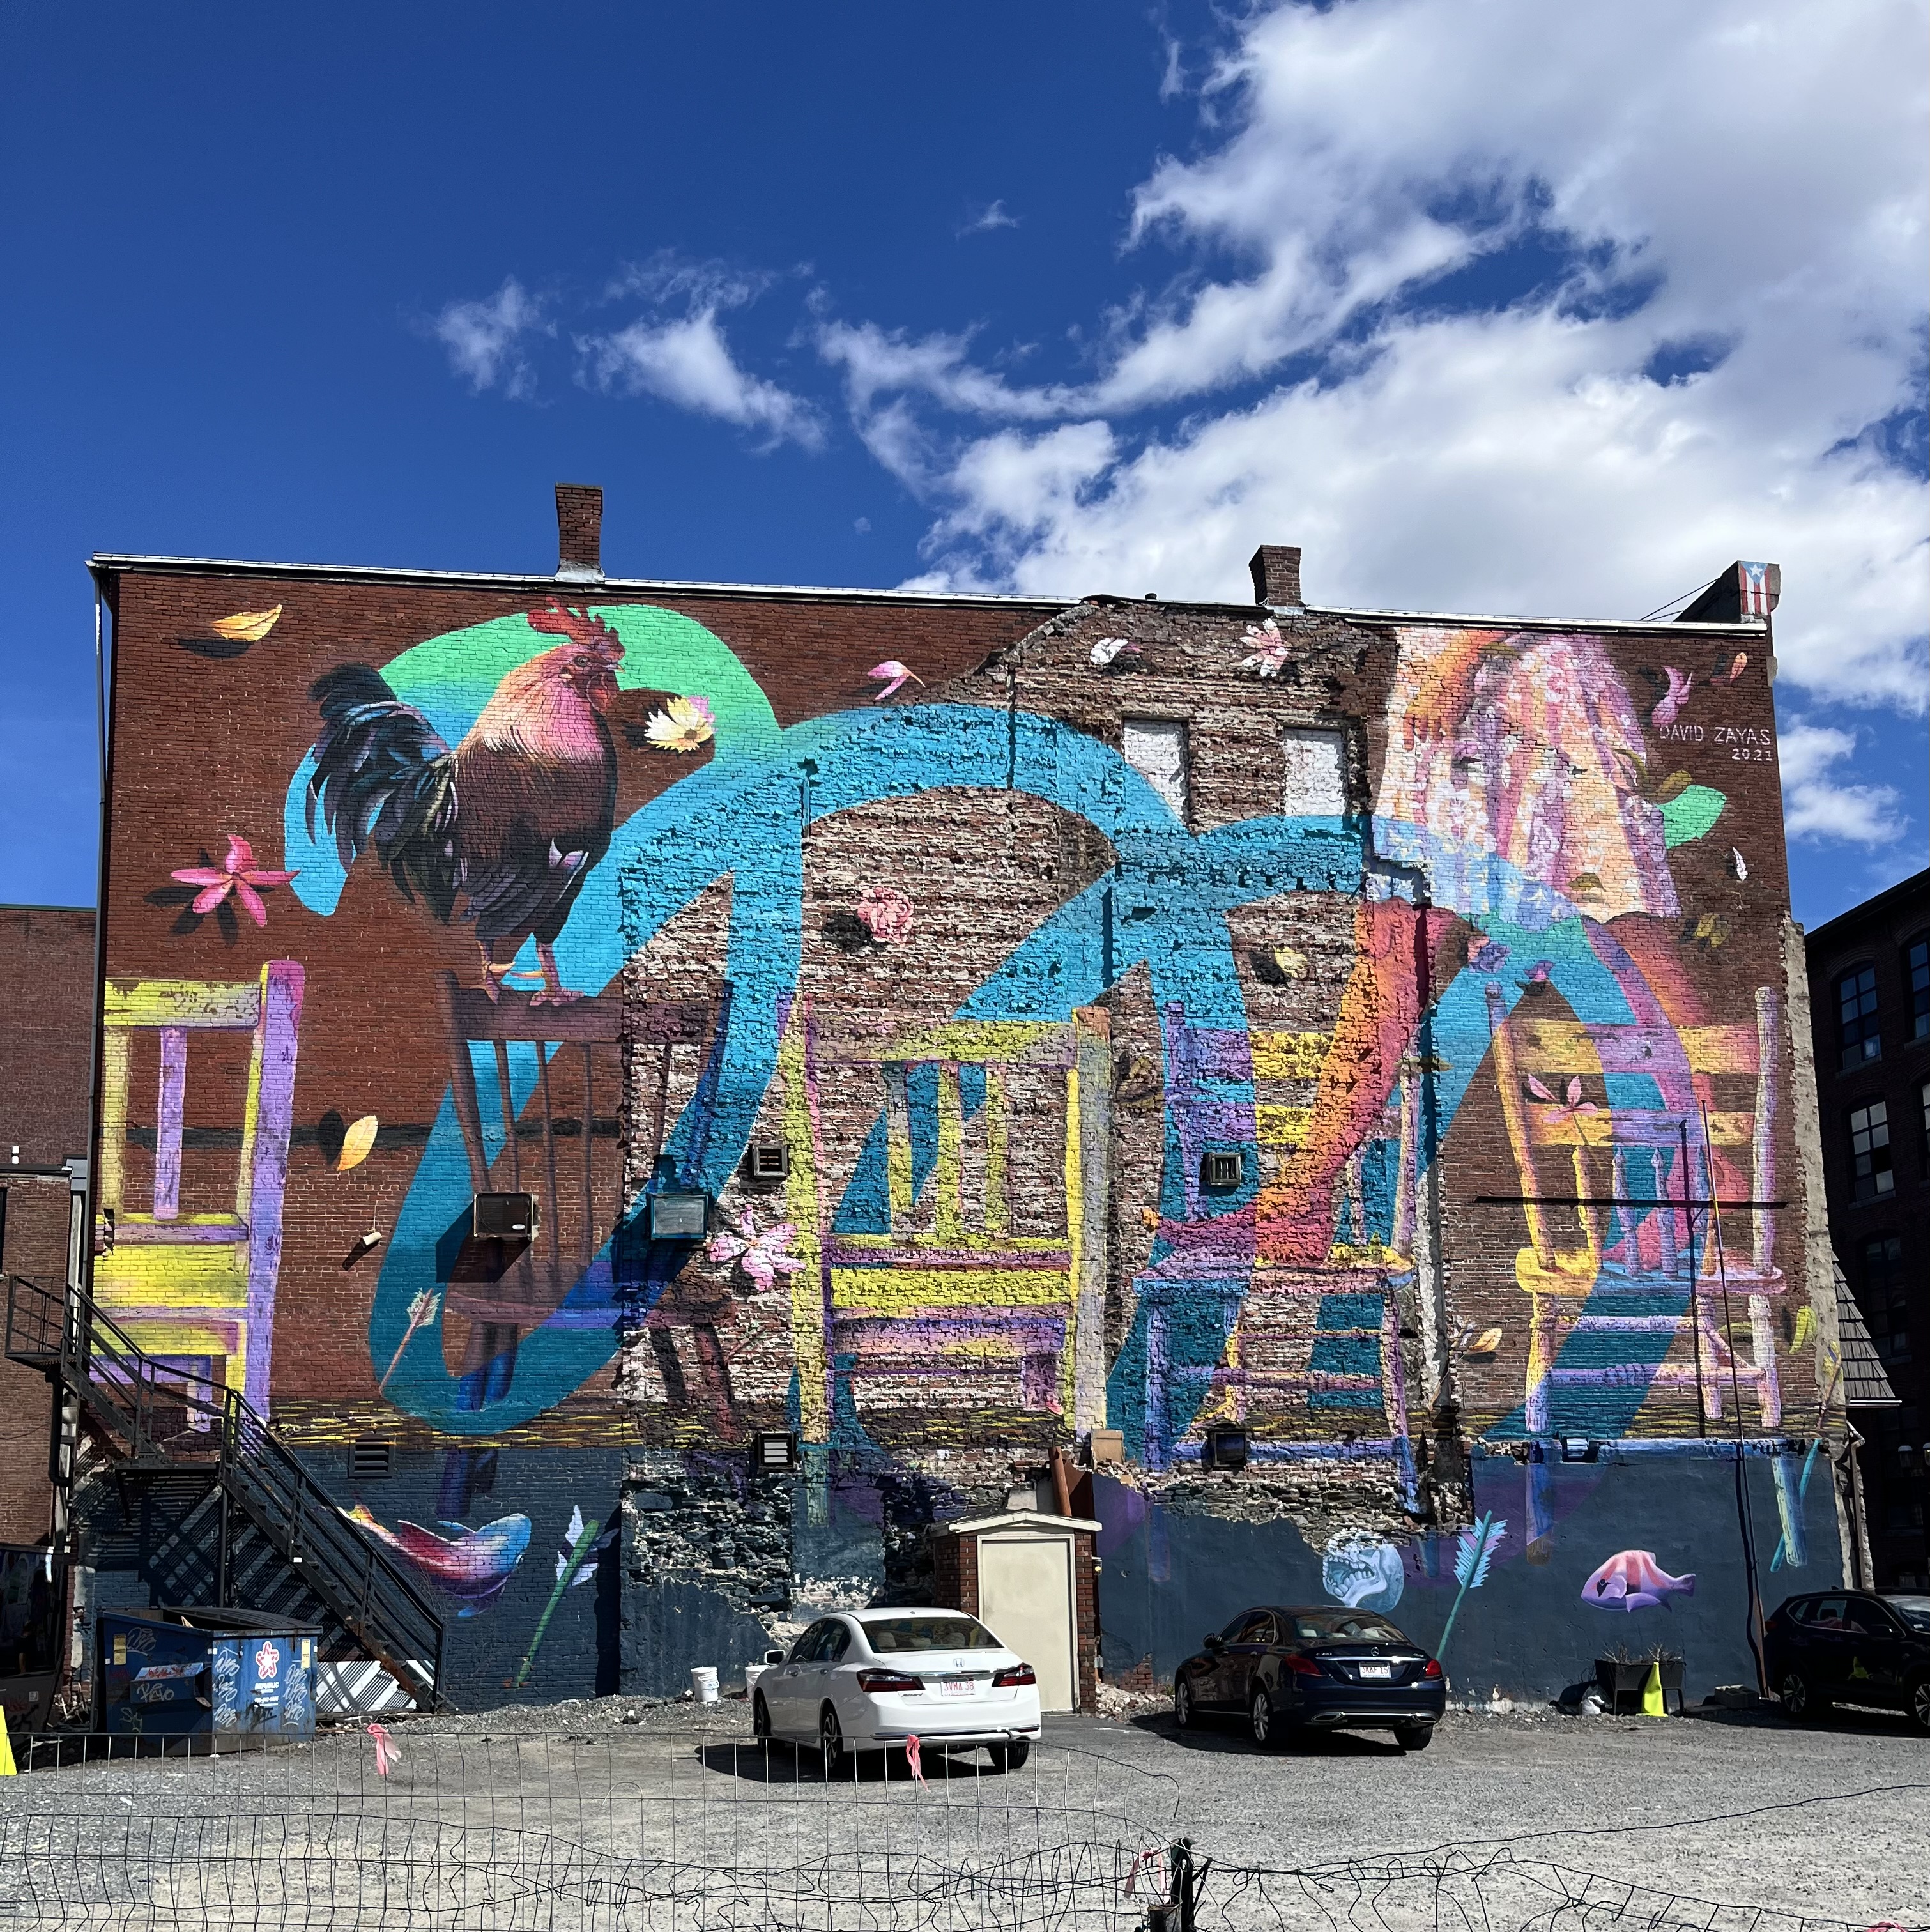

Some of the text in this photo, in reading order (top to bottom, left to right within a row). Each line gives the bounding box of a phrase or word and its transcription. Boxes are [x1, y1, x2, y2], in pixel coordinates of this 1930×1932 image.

[1659, 724, 1771, 746] DAVID ZAYAS
[1731, 748, 1773, 761] 2021
[965, 1681, 974, 1690] 38
